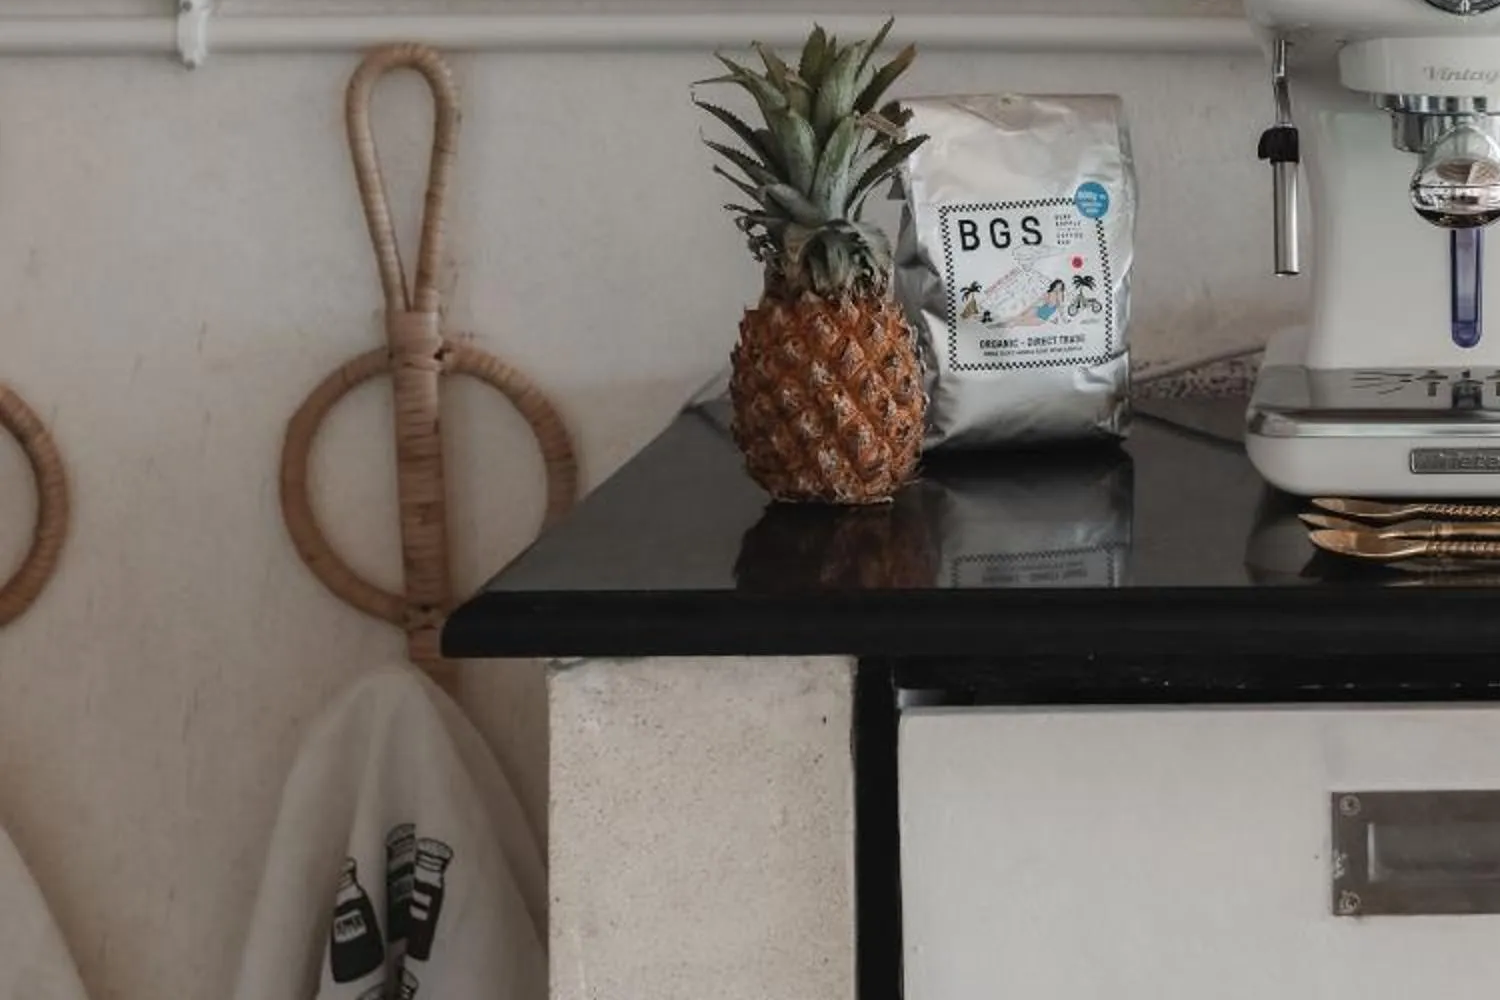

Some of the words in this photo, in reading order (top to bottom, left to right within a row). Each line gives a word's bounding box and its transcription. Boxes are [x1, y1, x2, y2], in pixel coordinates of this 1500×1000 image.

[957, 215, 1043, 252] BGS
[979, 338, 1018, 349] ORGANIC
[1027, 335, 1057, 347] DIRECT
